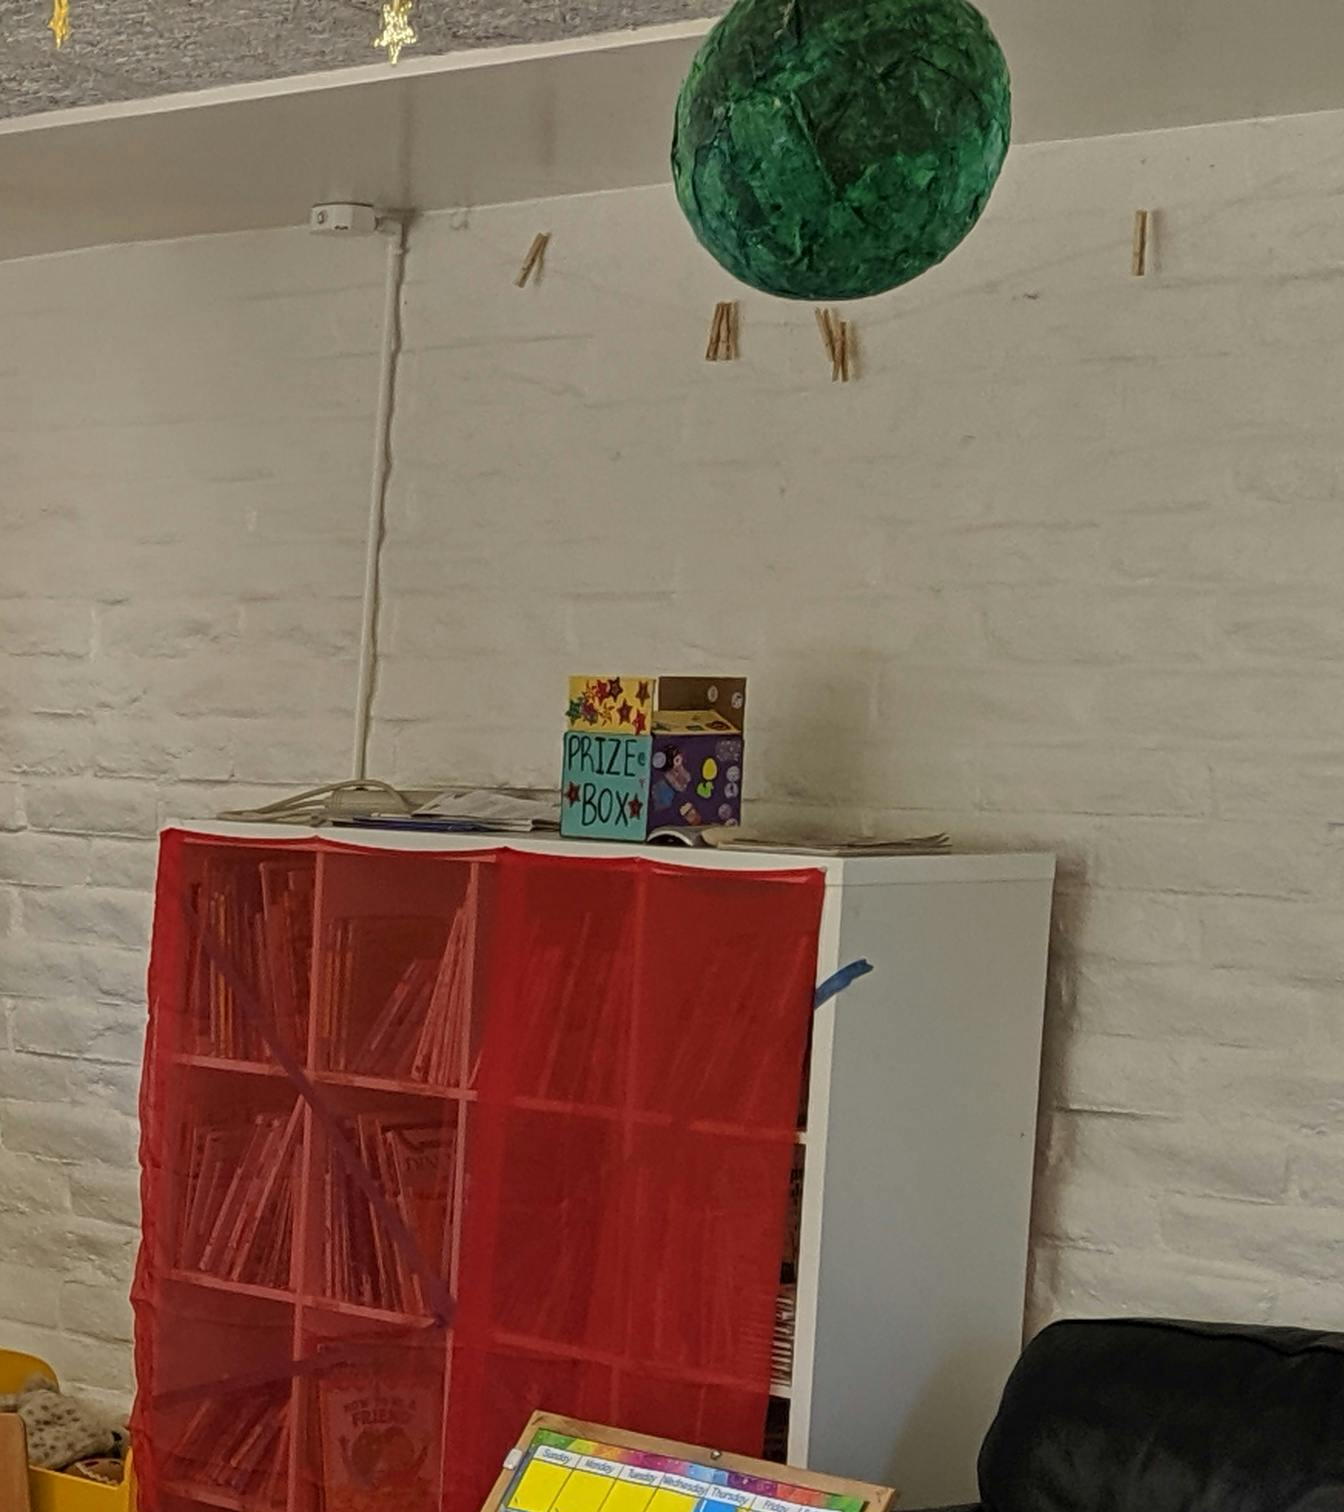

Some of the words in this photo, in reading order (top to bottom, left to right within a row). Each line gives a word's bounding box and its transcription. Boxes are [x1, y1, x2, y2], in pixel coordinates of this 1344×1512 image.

[568, 735, 637, 777] PRIZE
[581, 782, 630, 827] BOX
[542, 1449, 571, 1464] Sunday
[585, 1459, 615, 1474] Monday
[628, 1469, 657, 1483] Tuesday
[663, 1474, 706, 1495] Wednesday
[711, 1487, 749, 1506] Thursday
